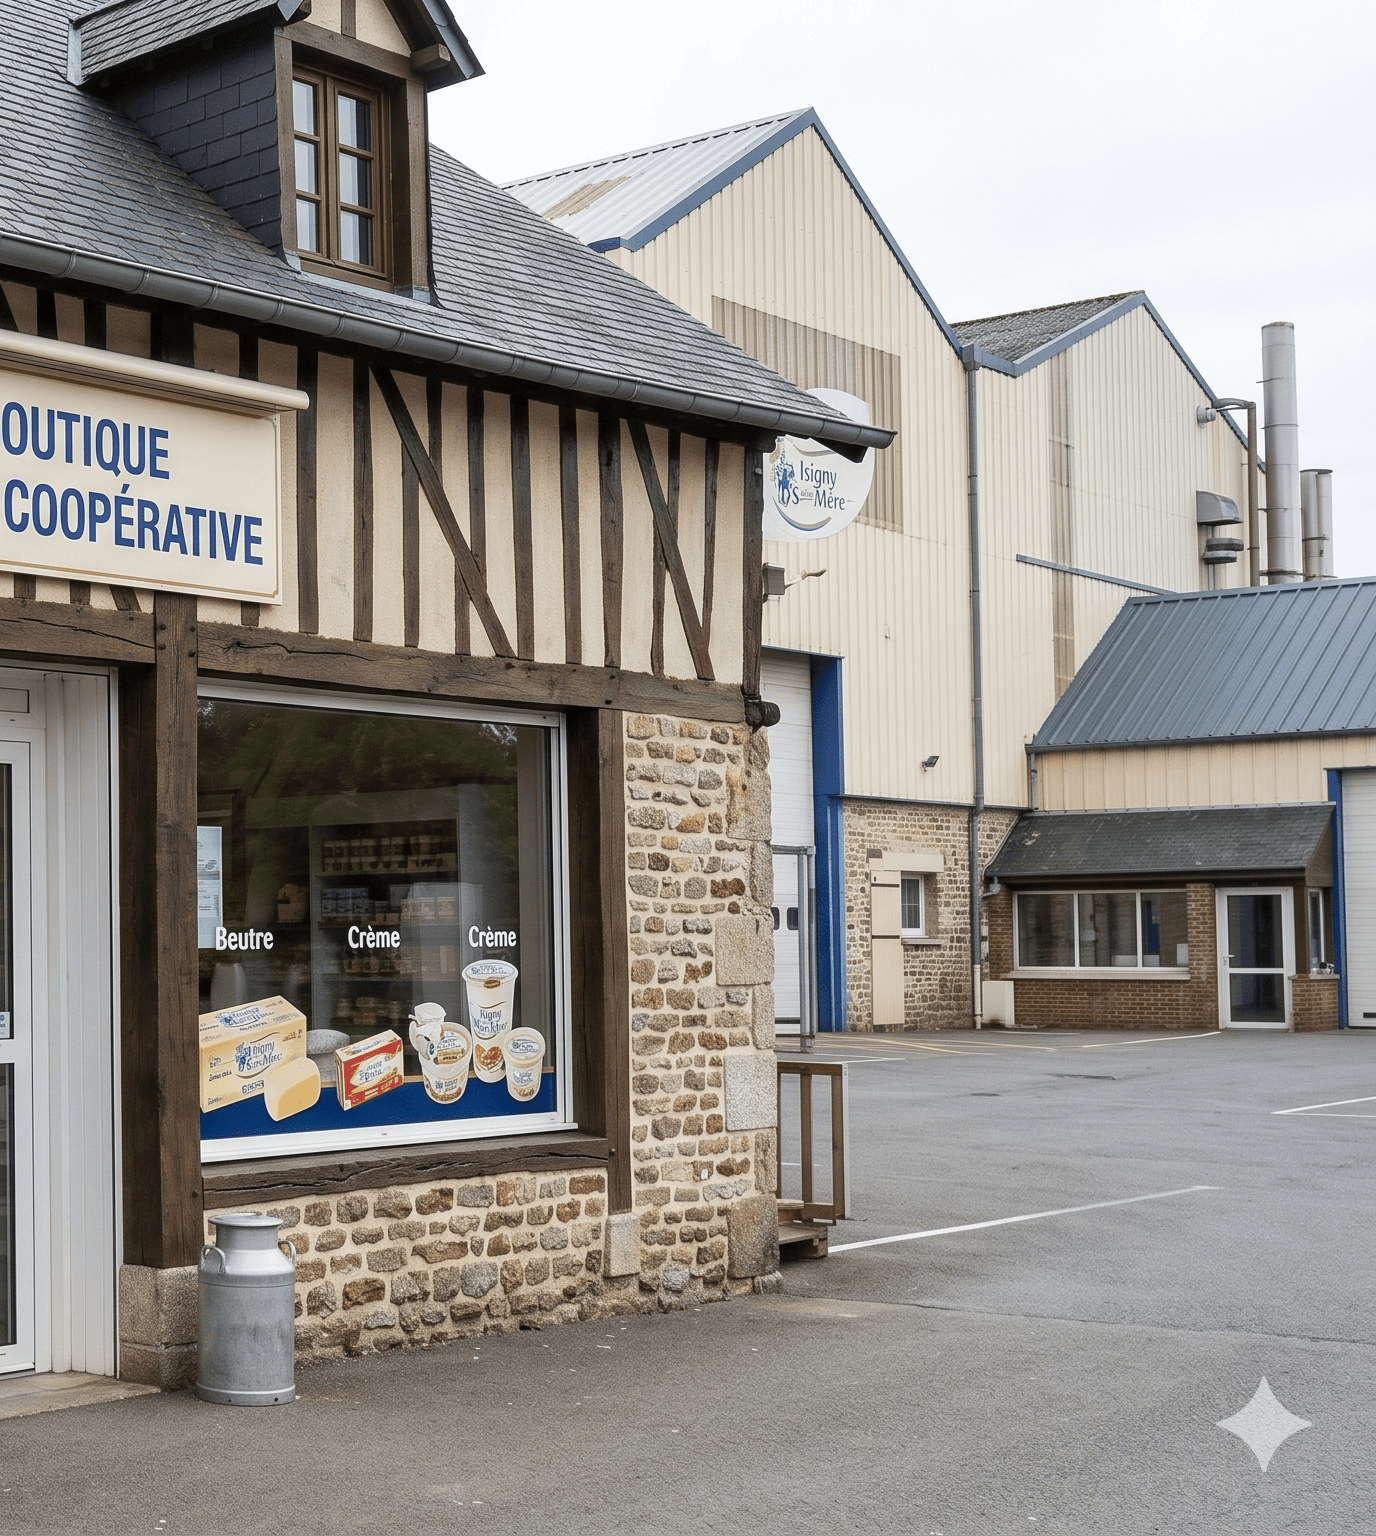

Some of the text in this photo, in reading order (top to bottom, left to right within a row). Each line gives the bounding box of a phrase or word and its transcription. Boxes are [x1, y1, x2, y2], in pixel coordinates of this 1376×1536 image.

[800, 460, 837, 490] Isigny
[4, 483, 264, 566] COOPÉRATIVE
[215, 926, 274, 951] Beutre
[347, 924, 401, 949] Crème
[468, 925, 517, 948] Crème
